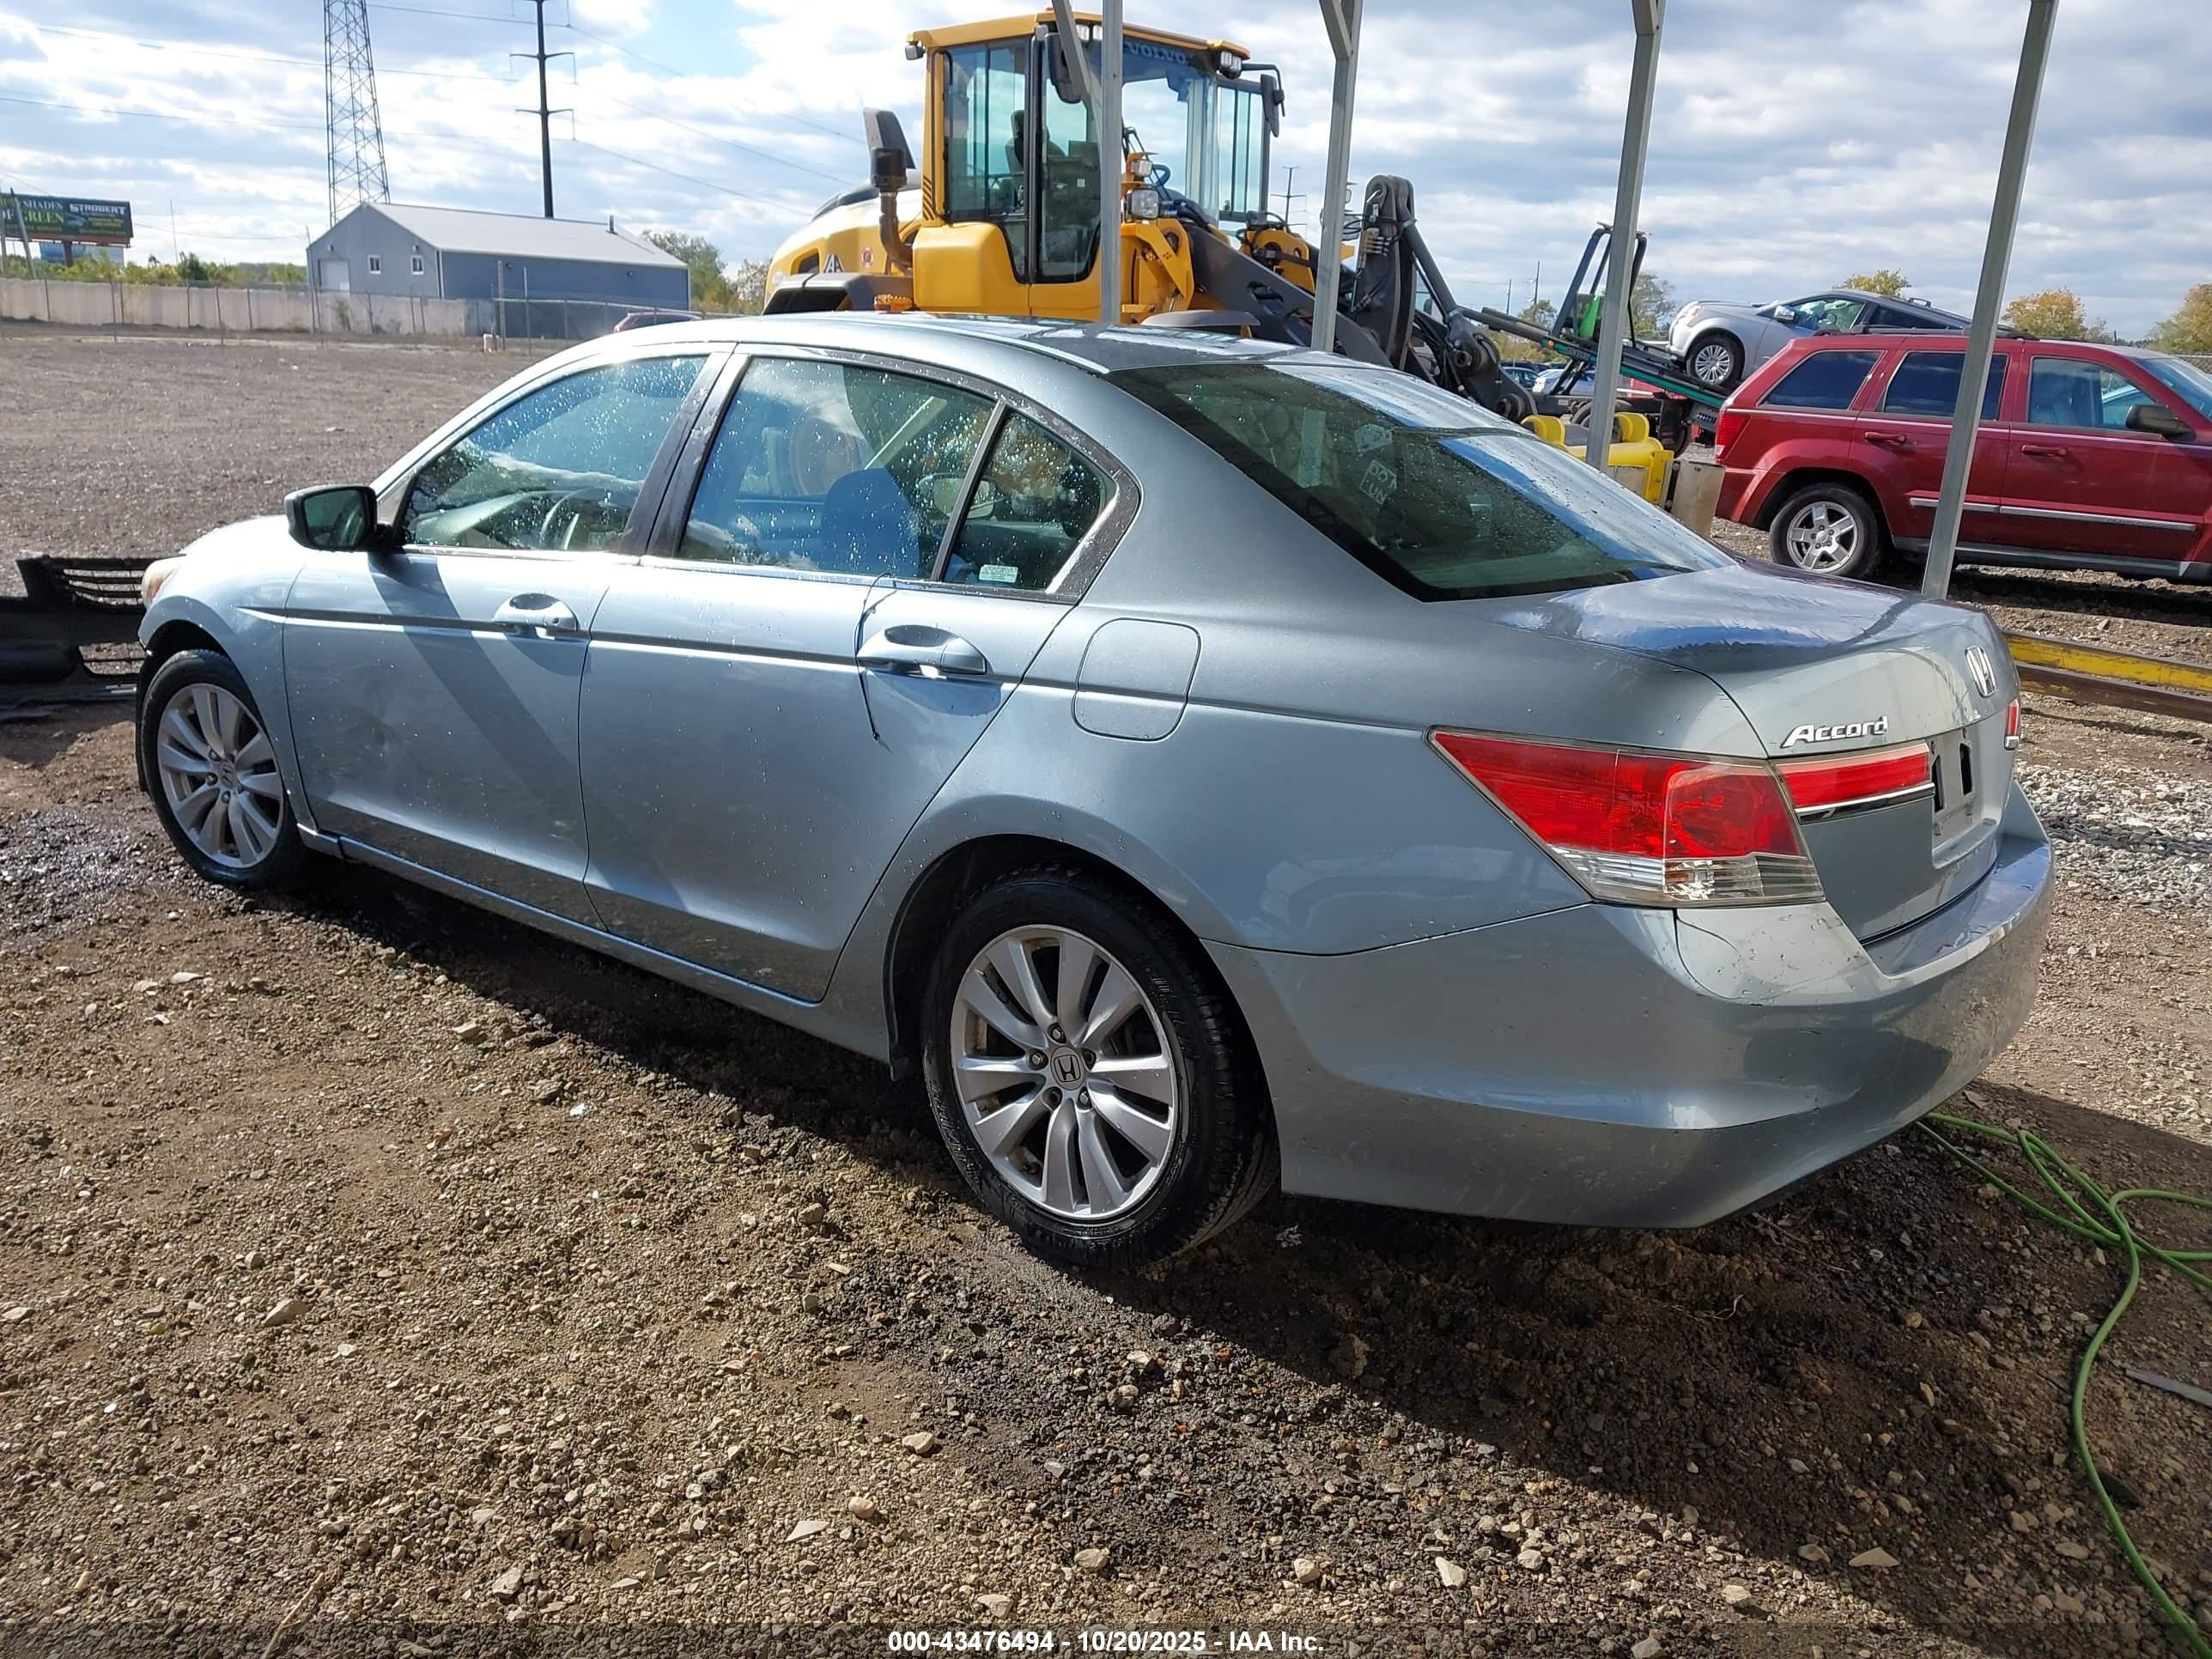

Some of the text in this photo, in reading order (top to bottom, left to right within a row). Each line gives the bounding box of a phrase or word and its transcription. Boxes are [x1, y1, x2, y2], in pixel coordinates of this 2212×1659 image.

[1124, 40, 1187, 64] VOLVO
[23, 200, 64, 210] SHADES
[70, 204, 126, 215] STROBERT
[1779, 715, 1888, 749] Accord
